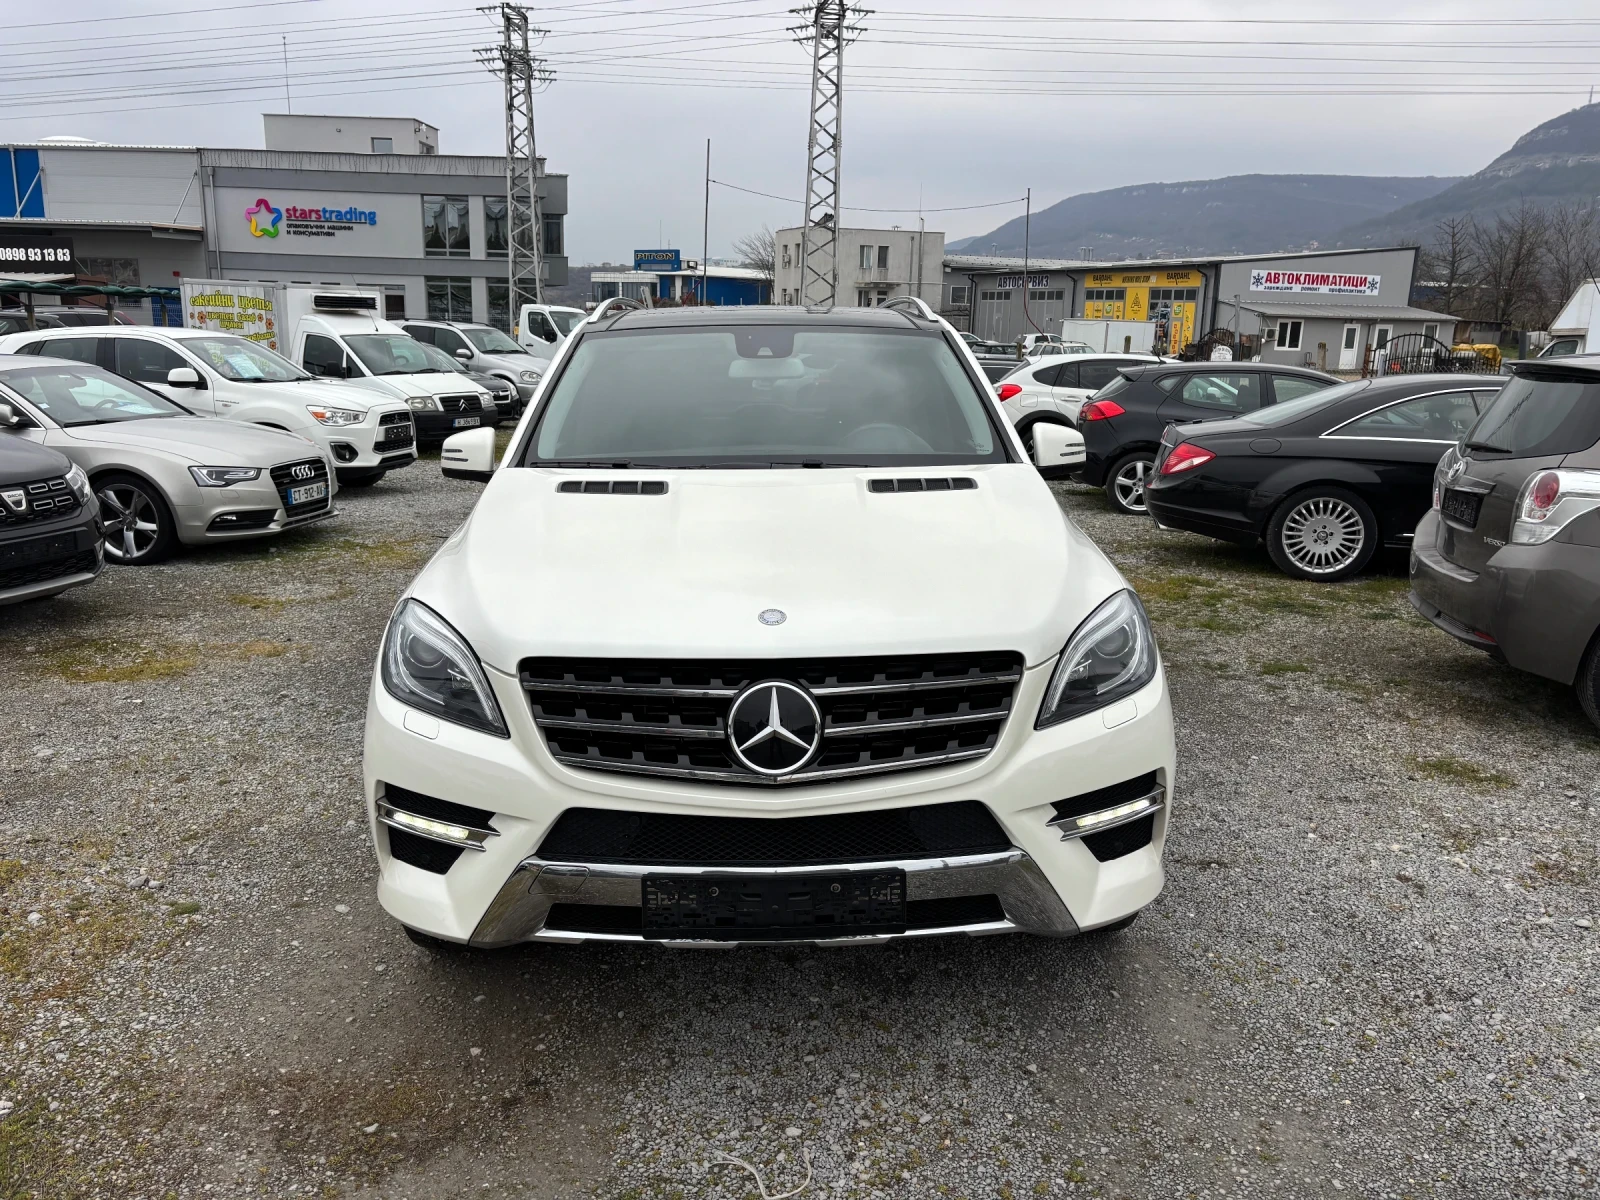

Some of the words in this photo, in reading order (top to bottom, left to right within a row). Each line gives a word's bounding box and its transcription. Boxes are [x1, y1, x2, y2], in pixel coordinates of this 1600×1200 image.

[285, 206, 377, 225] starstrading
[293, 229, 336, 237] консумативи
[0, 247, 26, 261] 0898
[28, 248, 42, 261] 93
[43, 248, 55, 261] 13
[56, 248, 71, 262] 83
[635, 252, 675, 261] PITON
[1166, 272, 1191, 284] BARDAHL
[1264, 271, 1368, 288] АВТОКЛИМАТИЦИ
